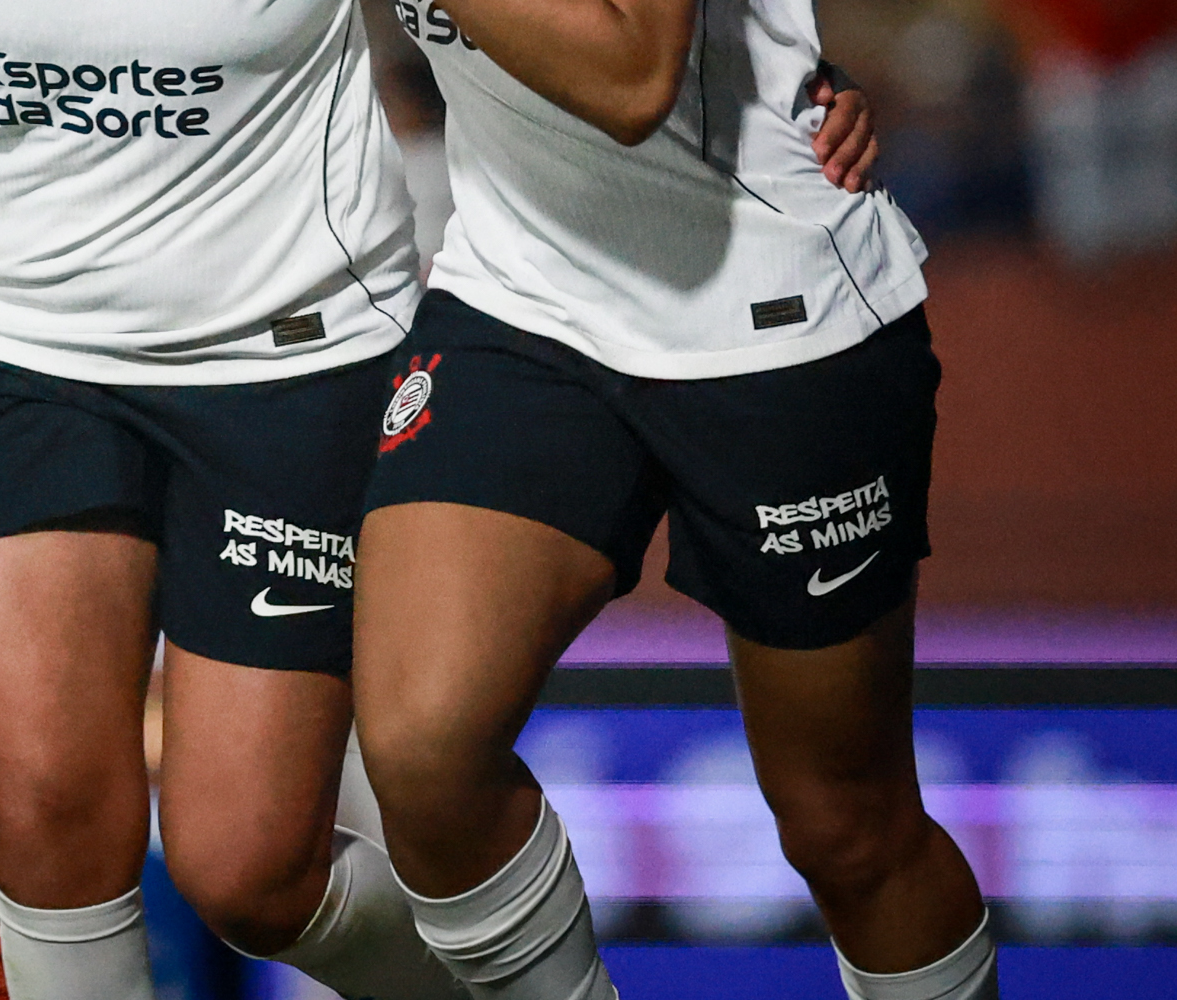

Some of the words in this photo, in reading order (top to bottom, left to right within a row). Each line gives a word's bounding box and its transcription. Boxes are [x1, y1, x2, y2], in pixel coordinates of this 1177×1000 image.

[755, 475, 889, 529] RESPEITA
[760, 529, 804, 555] AS
[810, 501, 893, 549] MINAS
[223, 509, 356, 563] RESPEITA
[219, 539, 258, 567] AS
[268, 550, 353, 589] MINAS
